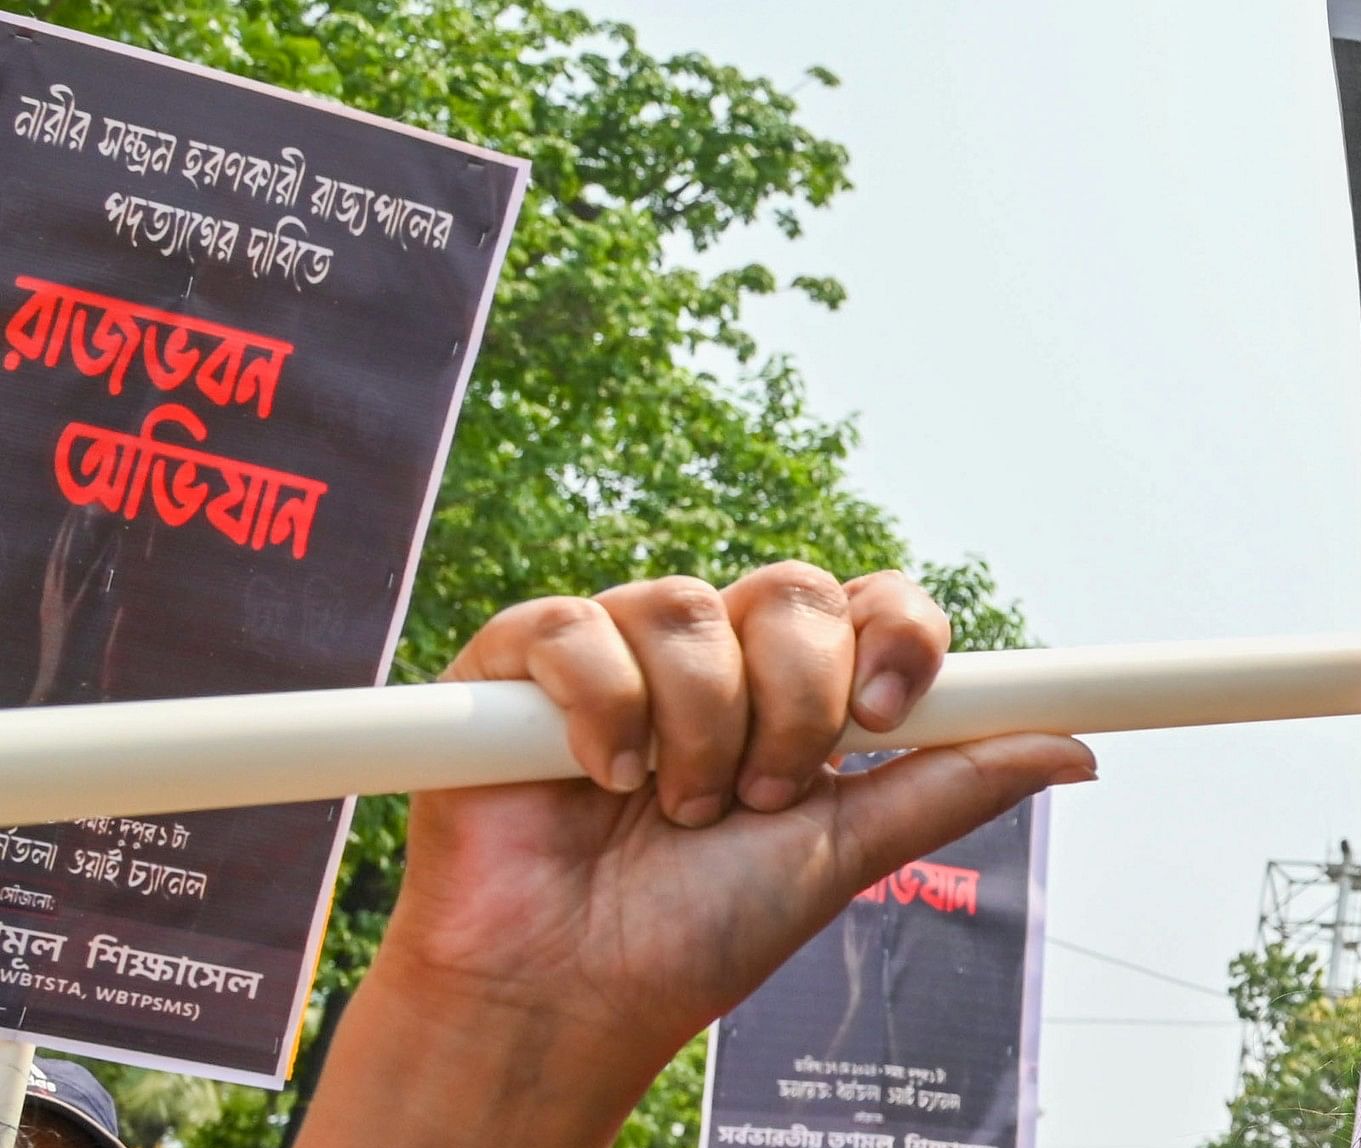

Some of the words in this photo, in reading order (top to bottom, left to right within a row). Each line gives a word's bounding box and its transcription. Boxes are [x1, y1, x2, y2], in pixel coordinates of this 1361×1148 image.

[13, 84, 91, 151] নারীর
[182, 140, 306, 206] হরণকারী
[310, 174, 454, 251] রাজ্যপালের
[104, 191, 241, 264] পদত্যাগের
[246, 214, 335, 292] দাবিতে
[3, 275, 294, 418] রাজভবন
[54, 403, 328, 560] অভিযান
[128, 858, 208, 900] চ্যানেল
[86, 933, 264, 1000] শিক্ষাসেল
[95, 985, 201, 1022] WBTPSMS)
